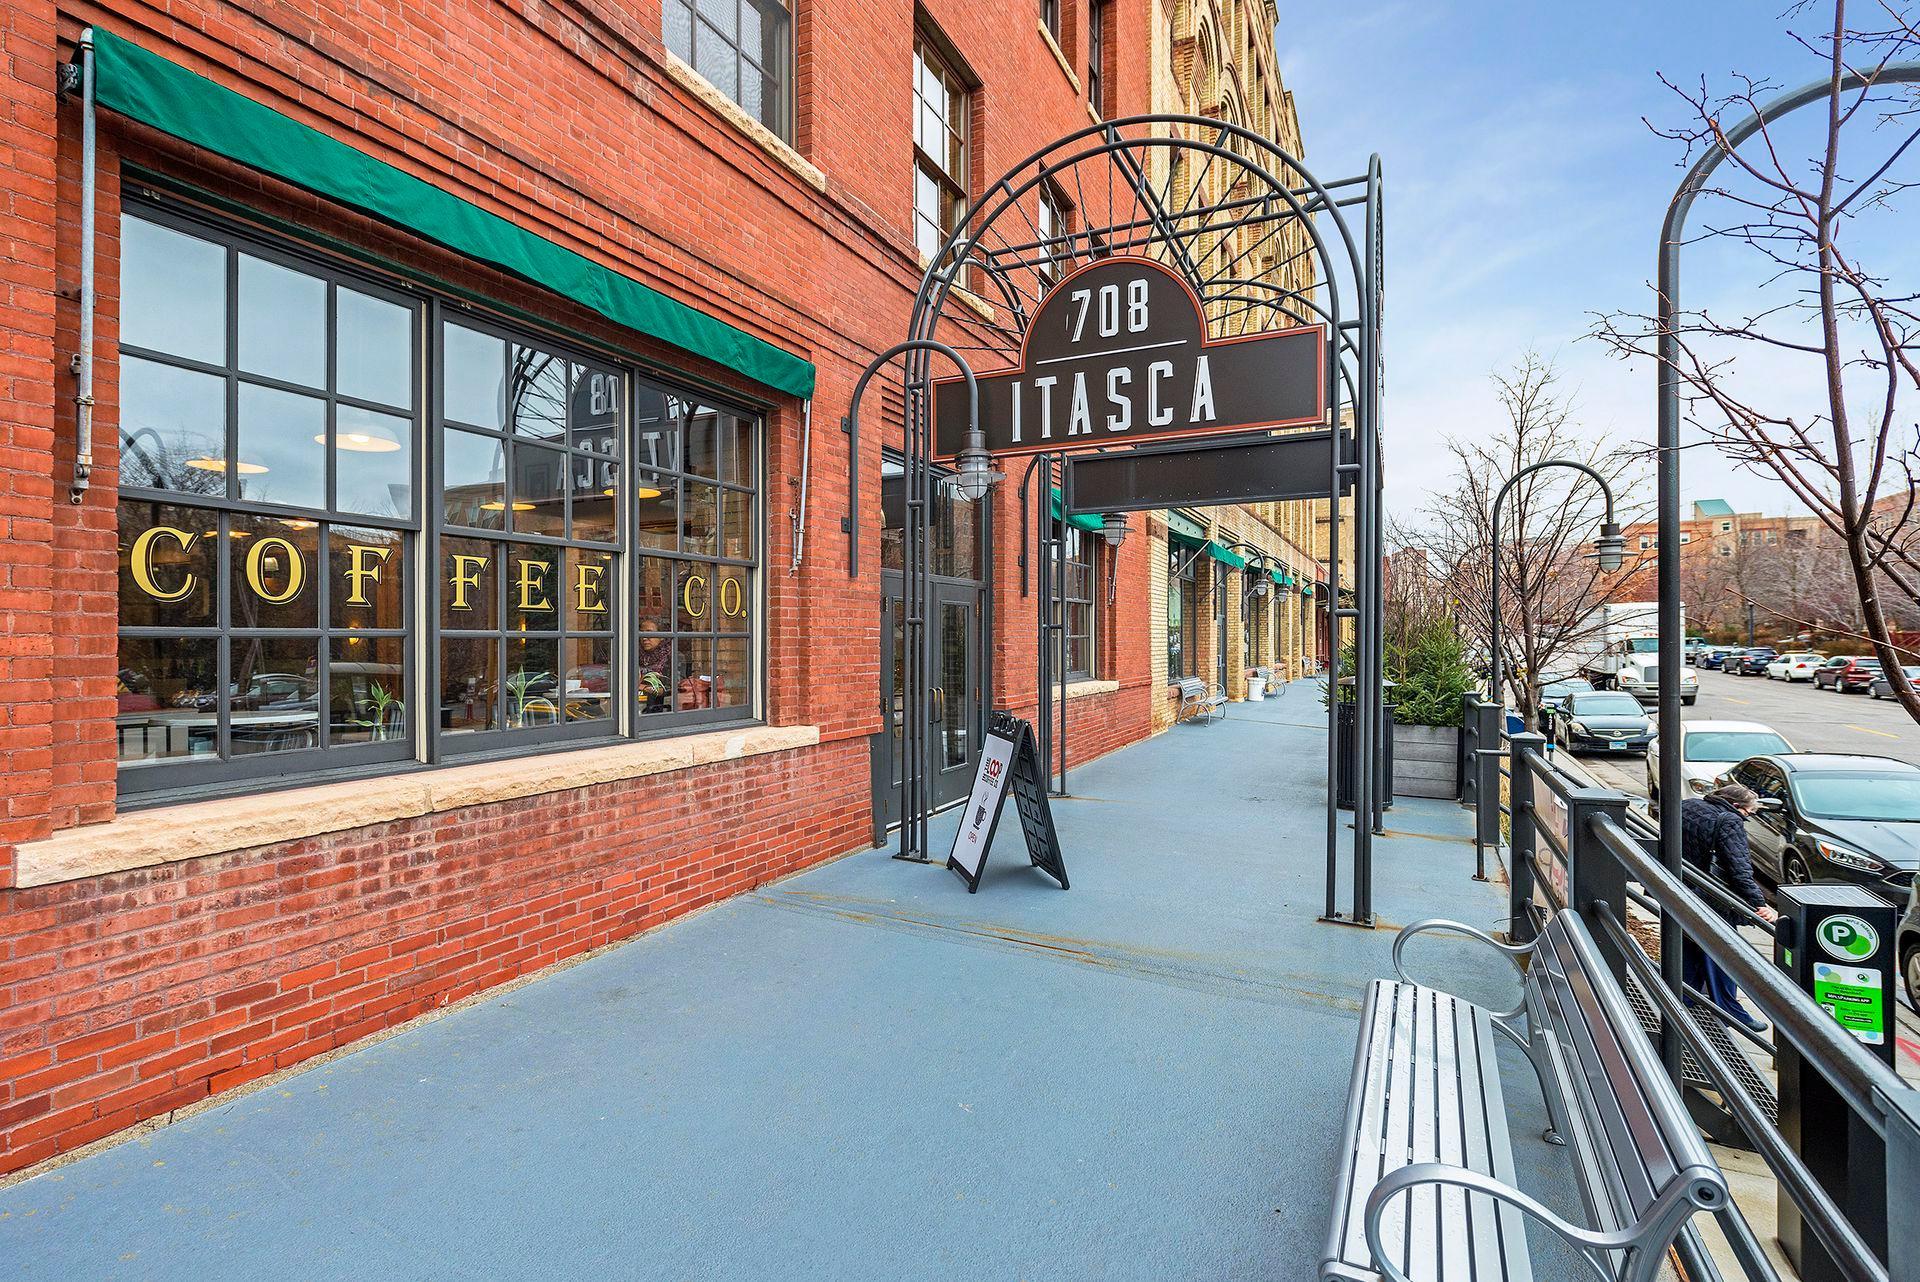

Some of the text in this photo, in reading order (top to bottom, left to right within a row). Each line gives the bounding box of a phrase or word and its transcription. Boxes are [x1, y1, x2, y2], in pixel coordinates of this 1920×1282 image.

[1071, 278, 1149, 343] 708
[1011, 355, 1216, 443] ITASCA
[130, 525, 748, 620] COFFEE CO.
[1831, 925, 1850, 943] P
